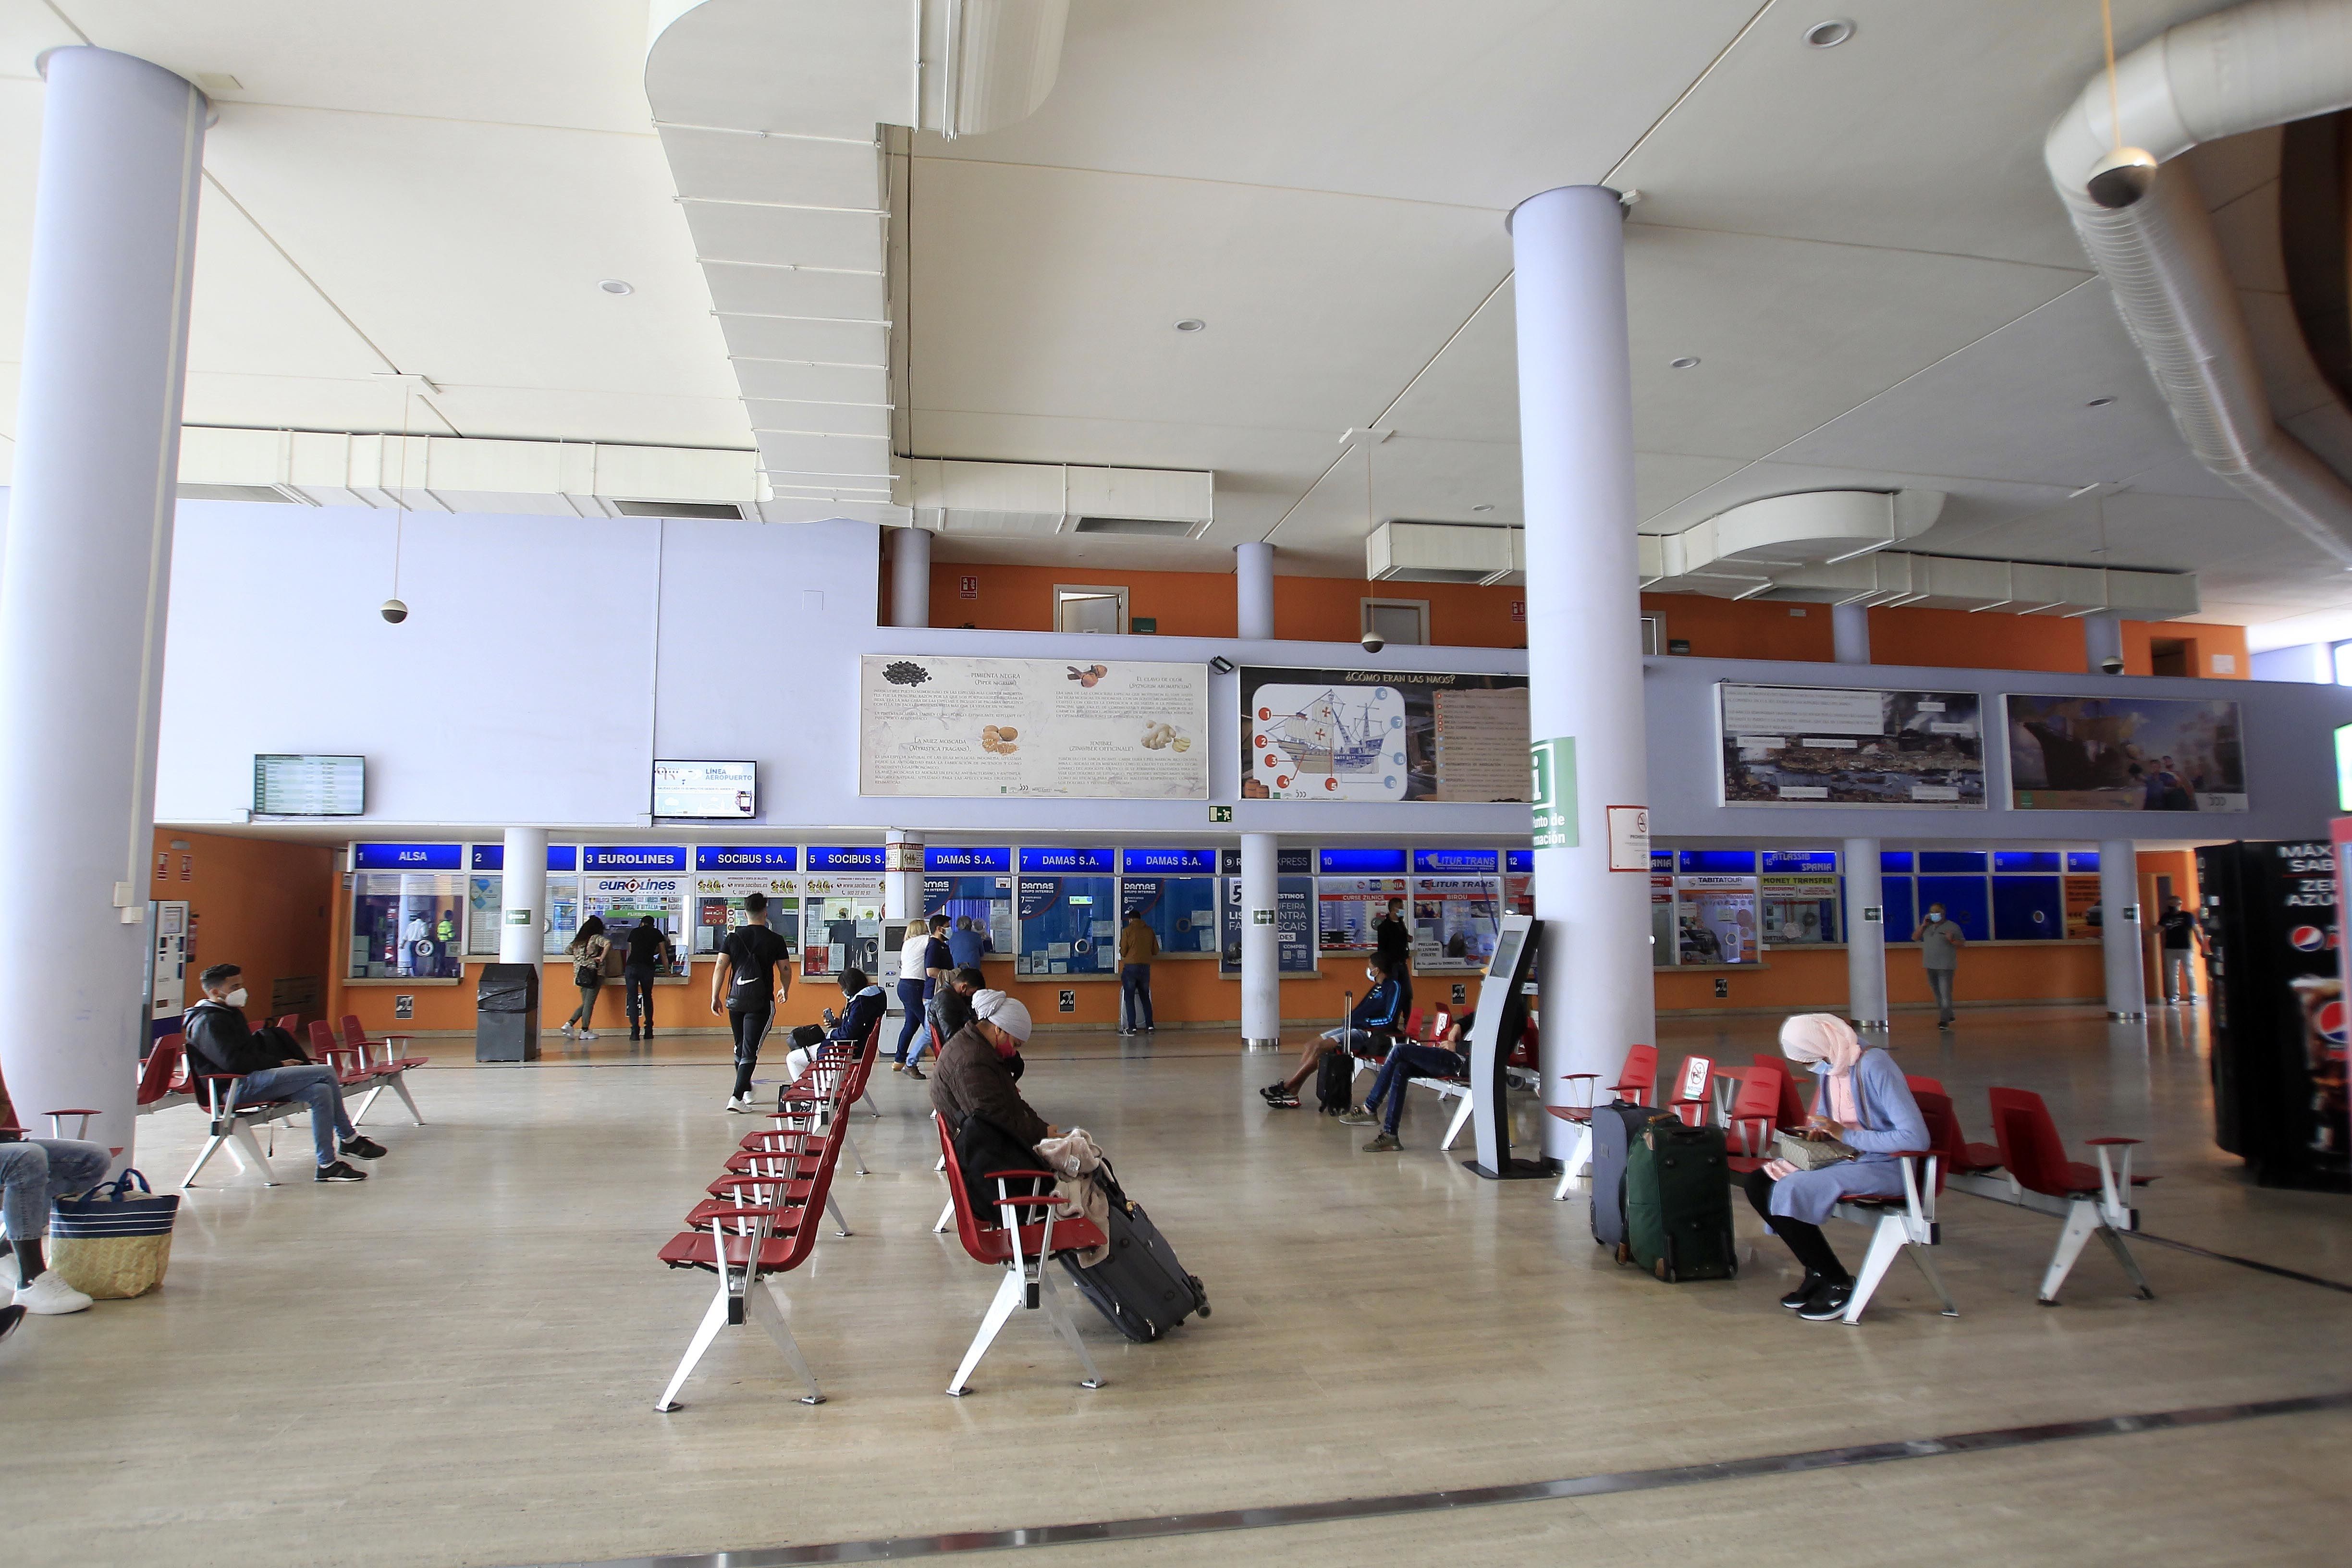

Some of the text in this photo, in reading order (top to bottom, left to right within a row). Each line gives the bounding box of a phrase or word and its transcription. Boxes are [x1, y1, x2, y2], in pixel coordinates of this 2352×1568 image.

[1346, 671, 1455, 685] ¿CÓMO ERAN LAS NAOS?
[1551, 813, 1566, 826] de
[1533, 831, 1566, 846] mación
[2278, 843, 2334, 858] MÁX
[358, 852, 364, 860] 1
[398, 852, 428, 861] ALSA
[475, 853, 482, 862] 2
[587, 854, 674, 864] 3 EUROLINES
[699, 855, 705, 863] 4
[718, 854, 787, 863] SOCIBUS S.A.
[809, 855, 816, 863] 5
[828, 855, 884, 863] SOCIBUS S.
[937, 855, 995, 864] DAMAS S.A.
[1042, 857, 1099, 865] DAMAS S.A.
[1146, 857, 1201, 865] DAMAS S.A.
[1324, 857, 1332, 865] 10
[1418, 857, 1424, 865] 11
[1466, 857, 1495, 865] TRANS
[1652, 859, 1672, 868] ANIA
[1802, 863, 1832, 871] SPANIA
[2289, 859, 2335, 872] SAB
[698, 881, 724, 889] Socibus
[771, 881, 797, 889] Socibus
[808, 881, 834, 889] Socibus
[2286, 892, 2334, 906] AZÚ
[1278, 922, 1307, 931] SCAIS
